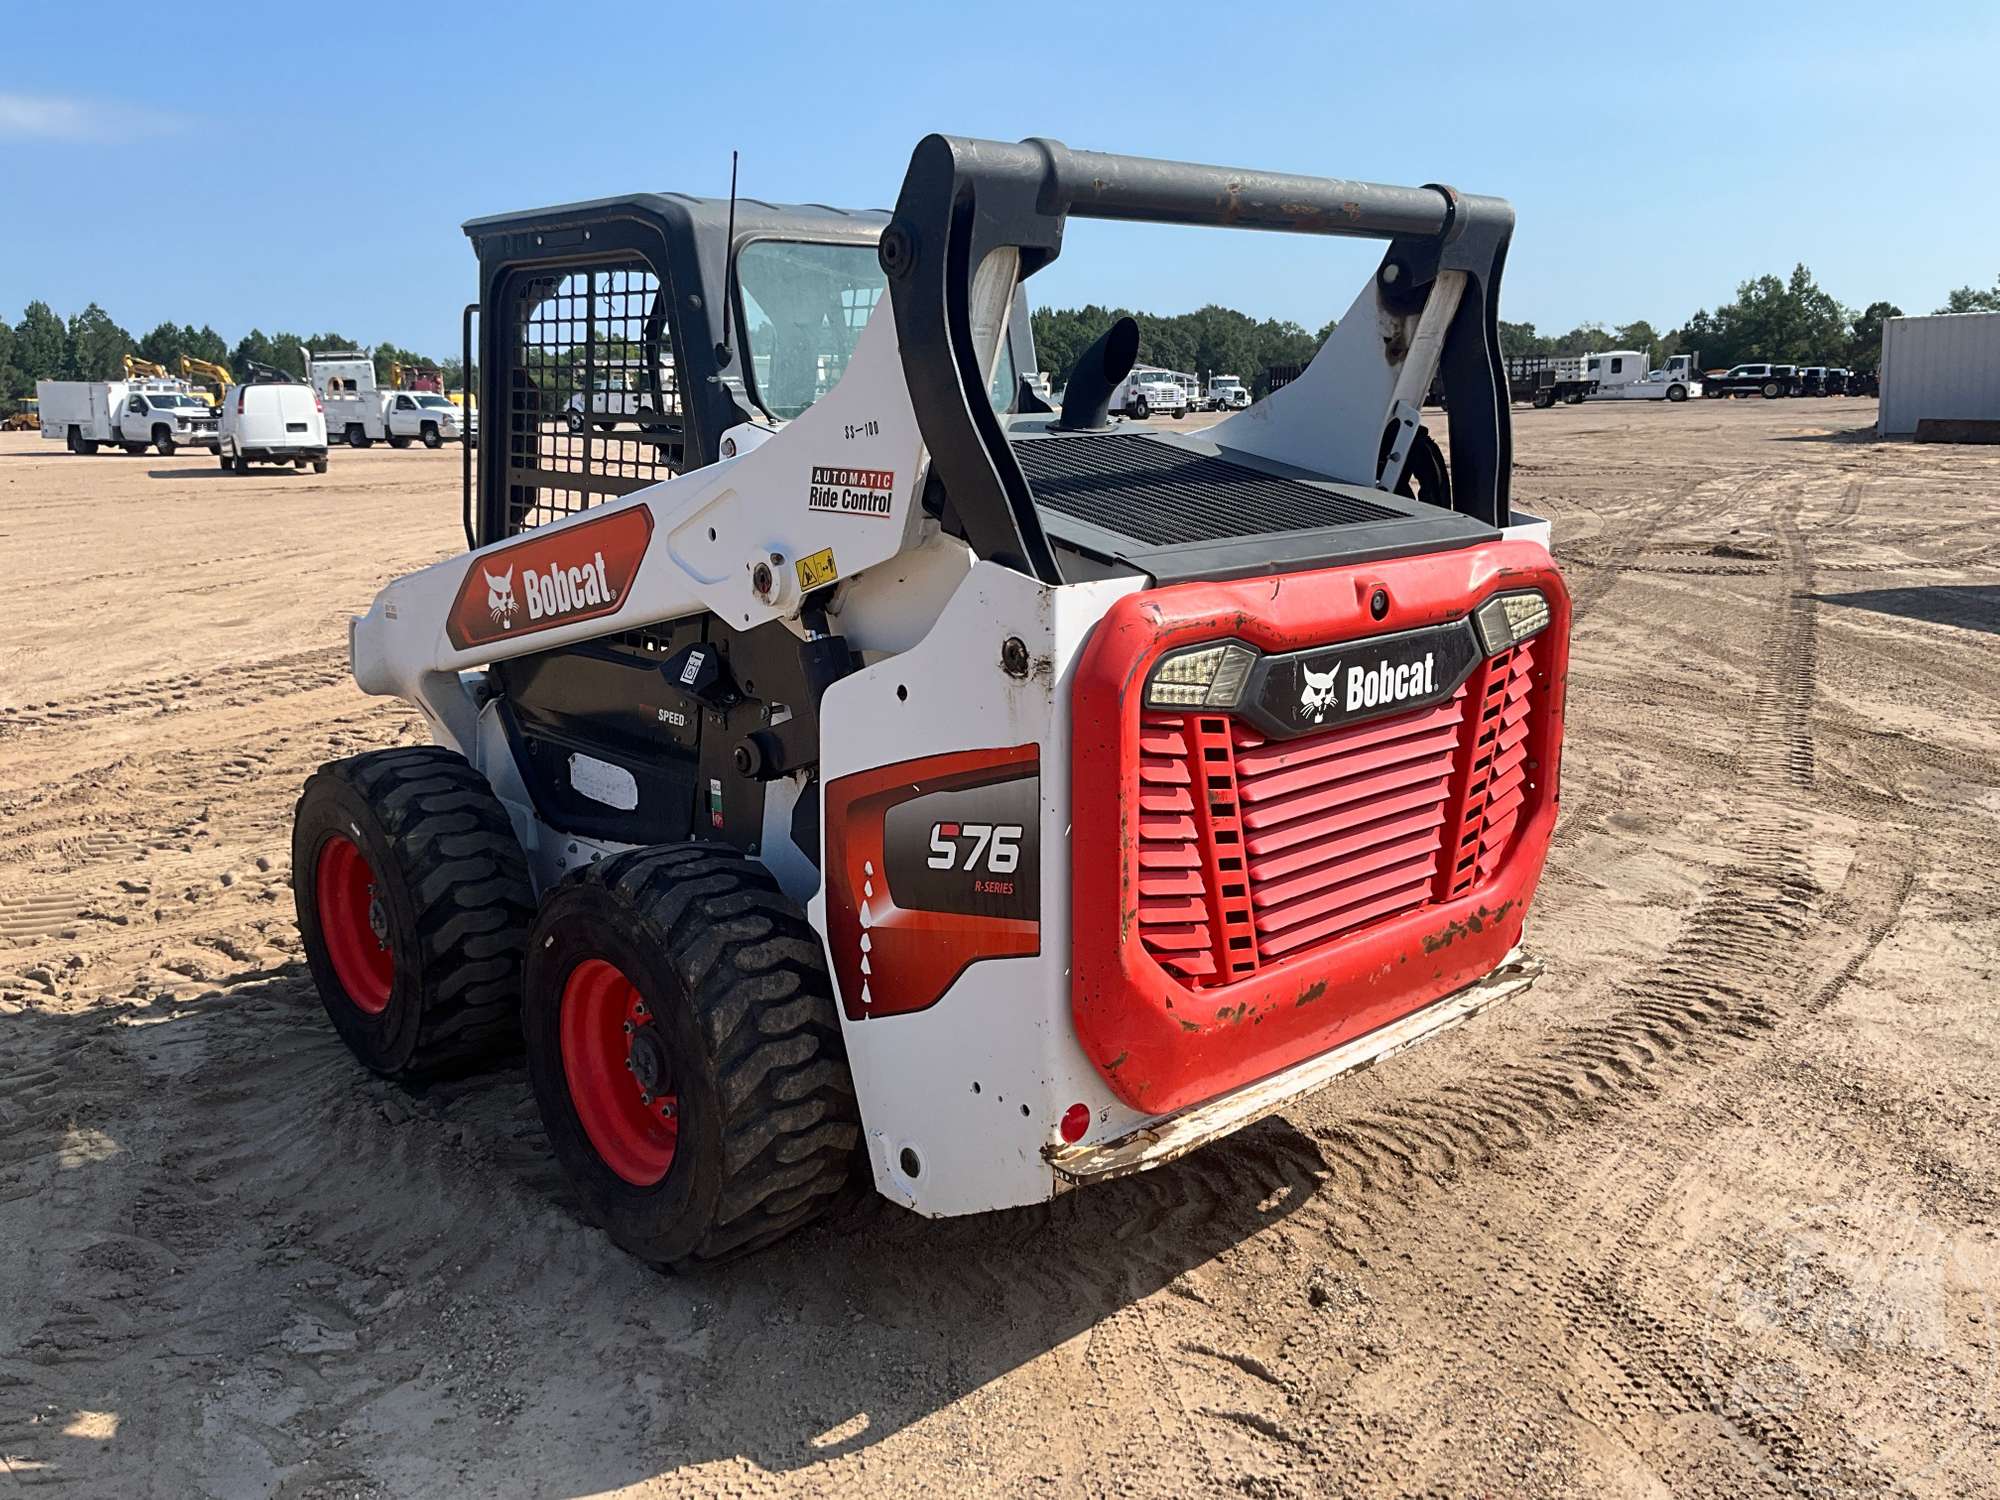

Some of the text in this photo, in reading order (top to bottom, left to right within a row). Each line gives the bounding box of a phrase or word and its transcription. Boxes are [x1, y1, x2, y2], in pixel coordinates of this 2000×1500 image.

[814, 469, 891, 488] AUTOMATIC
[809, 486, 892, 513] Ride Control
[522, 551, 611, 620] Bobcat
[1346, 652, 1434, 712] Bobcat
[657, 708, 685, 727] SPEED
[927, 823, 1023, 873] S76
[975, 880, 1014, 895] R-SERIES
